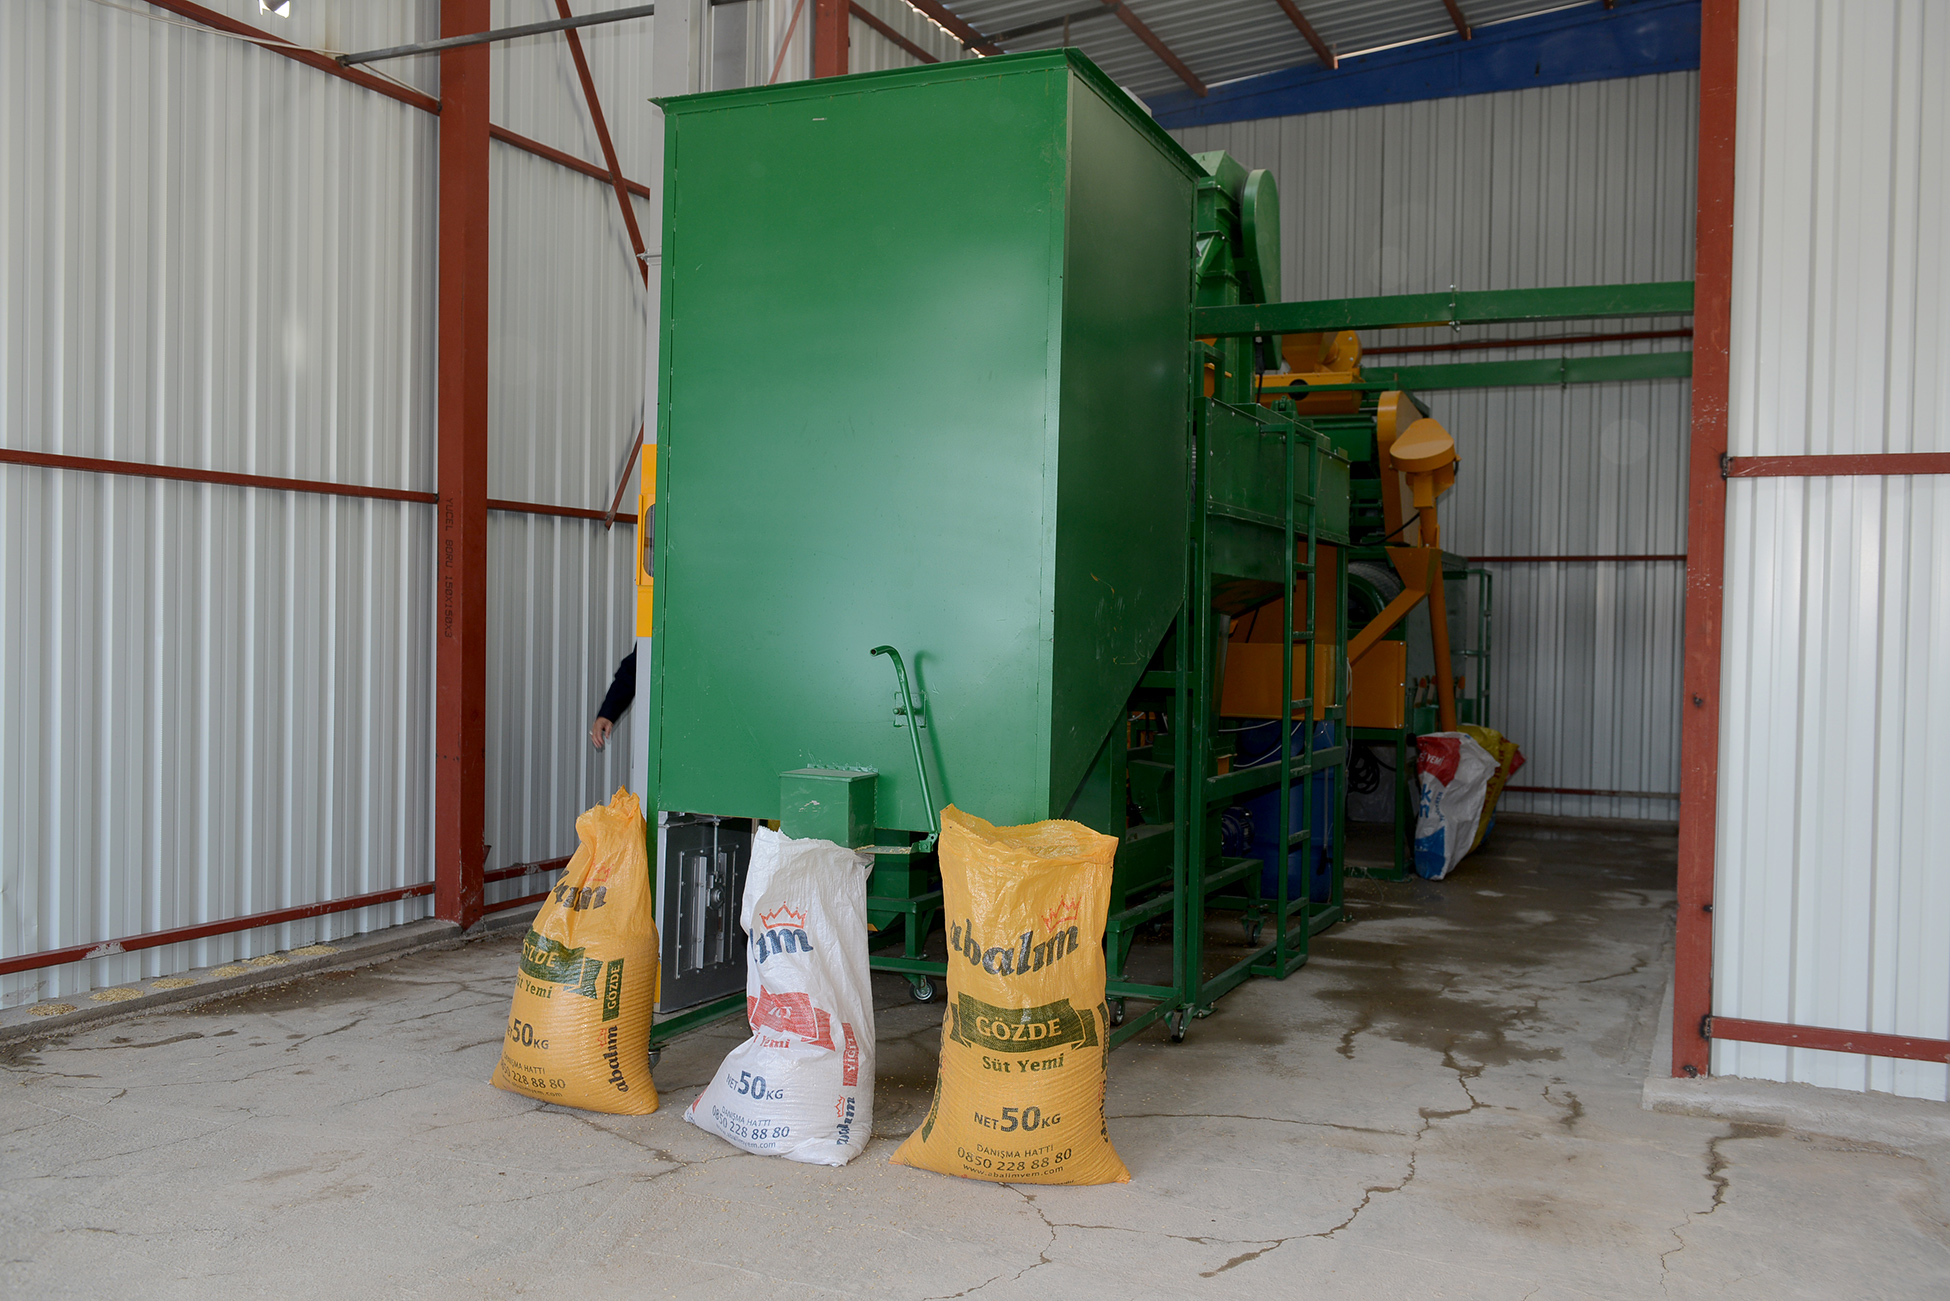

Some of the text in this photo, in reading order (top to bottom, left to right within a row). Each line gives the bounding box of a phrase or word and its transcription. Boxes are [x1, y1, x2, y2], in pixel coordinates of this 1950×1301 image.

[445, 497, 453, 531] YUCEL
[445, 539, 453, 568] BORU
[525, 979, 553, 998] Yemi
[512, 1018, 534, 1047] 50
[534, 1038, 549, 1050] KG
[975, 1015, 1062, 1041] GÖZDE
[982, 1052, 1065, 1073] Süt Yemi
[511, 1070, 529, 1086] 228
[531, 1077, 547, 1089] 88
[549, 1078, 566, 1090] 80
[725, 1070, 784, 1100] NET 50 KG
[729, 1121, 748, 1138] 228
[751, 1128, 768, 1140] 88
[772, 1126, 790, 1138] 80
[974, 1106, 1061, 1133] NET 50 KG
[957, 1147, 1072, 1171] 0850 228 88 80
